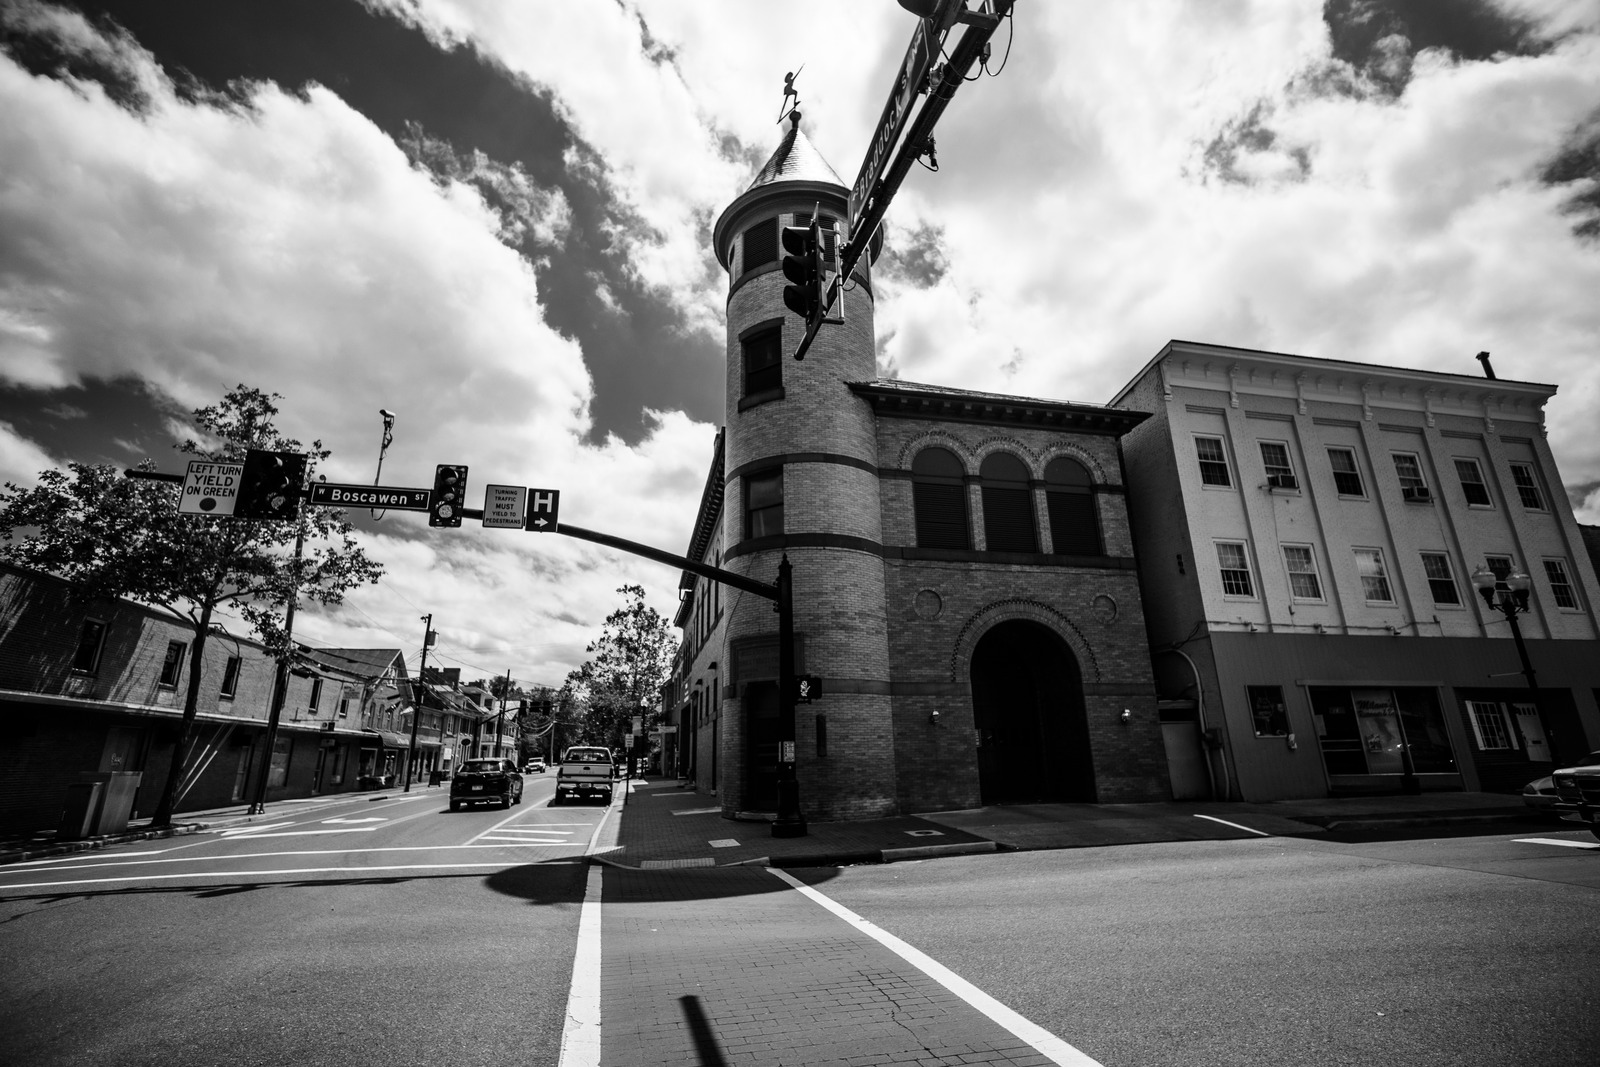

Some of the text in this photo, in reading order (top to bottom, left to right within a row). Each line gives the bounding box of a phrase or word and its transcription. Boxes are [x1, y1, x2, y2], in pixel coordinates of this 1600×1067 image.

[859, 94, 902, 200] Braddock
[189, 464, 242, 476] LEFT TURN
[194, 474, 234, 487] YIELD
[186, 486, 236, 497] ON GREEN
[331, 489, 408, 505] Boscawen
[533, 491, 553, 513] H
